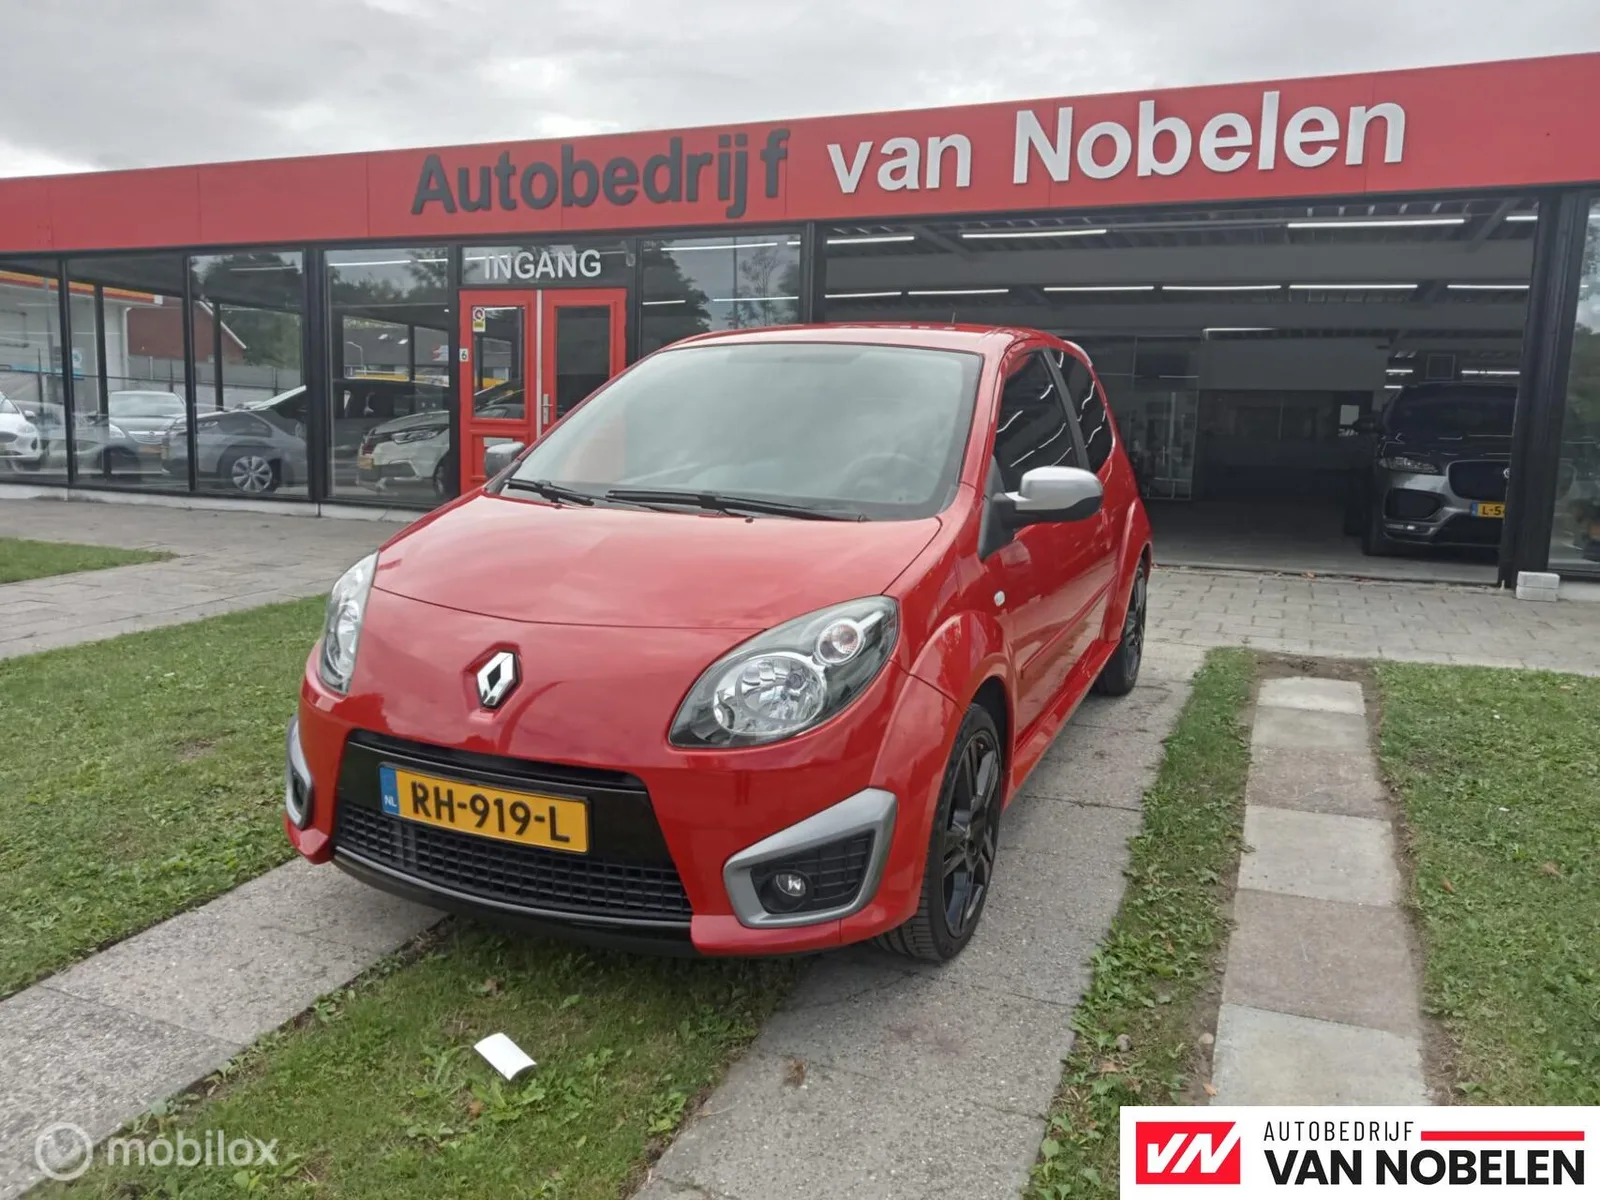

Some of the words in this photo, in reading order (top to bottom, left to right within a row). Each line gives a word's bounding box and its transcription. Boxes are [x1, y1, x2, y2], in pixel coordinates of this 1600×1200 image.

[411, 128, 790, 218] Autobedrijf
[827, 133, 972, 194] van
[1013, 90, 1406, 185] Nobelen
[484, 249, 602, 280] INGANG
[1482, 505, 1505, 516] L-5
[384, 796, 397, 808] NL
[411, 780, 570, 843] RH-919-L
